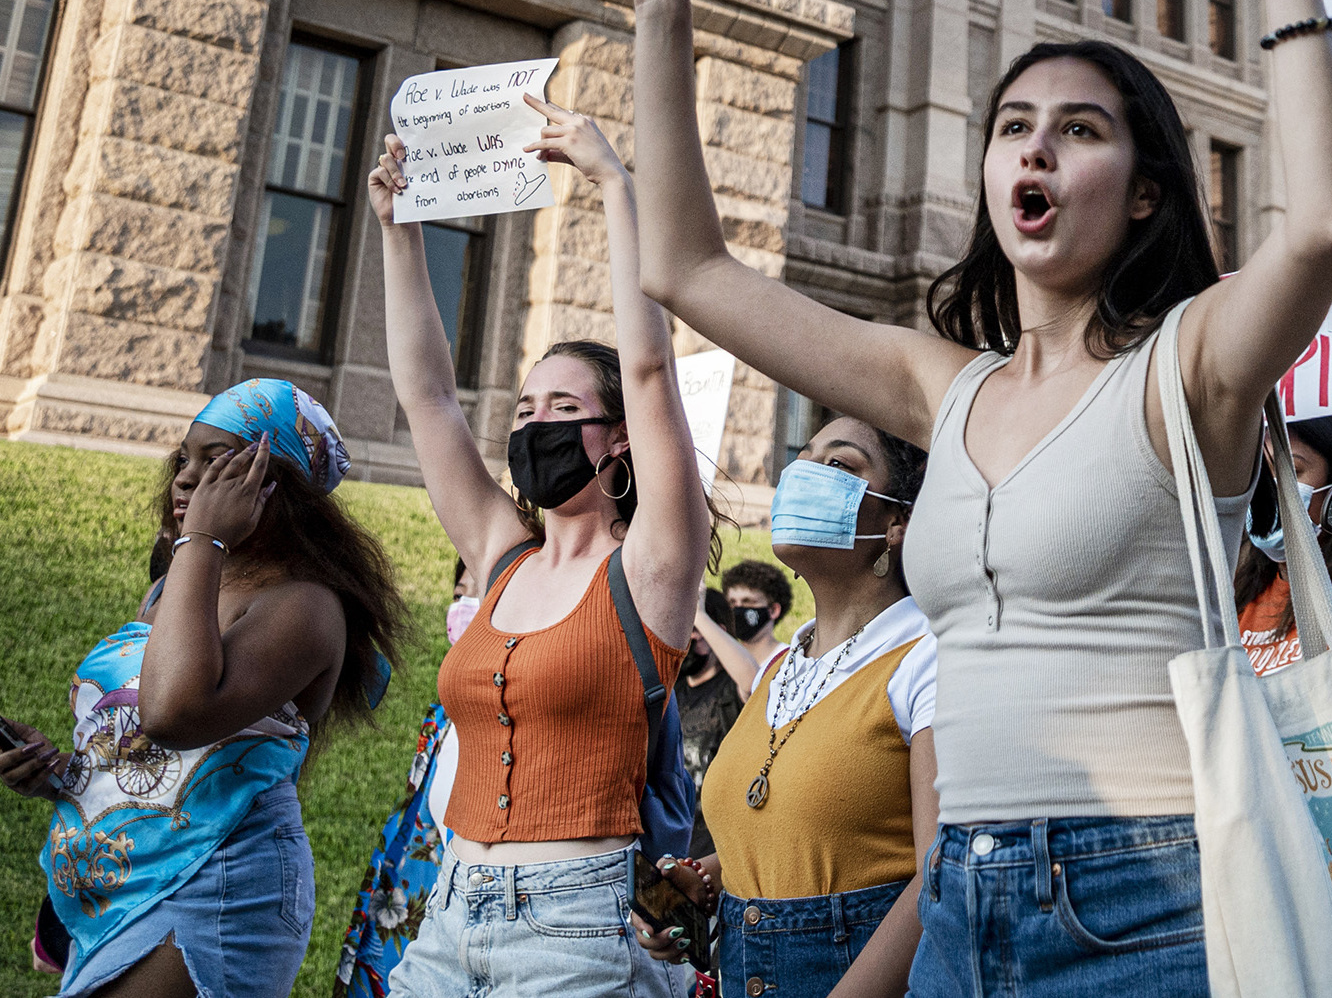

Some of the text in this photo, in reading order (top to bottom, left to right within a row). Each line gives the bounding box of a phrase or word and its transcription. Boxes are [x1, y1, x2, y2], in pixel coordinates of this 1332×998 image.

[405, 82, 428, 104] Roe
[450, 78, 479, 99] Wade
[482, 83, 501, 93] was
[397, 100, 511, 129] the beginning of abortions
[440, 141, 468, 156] Wade
[477, 134, 504, 152] WAS
[420, 167, 440, 184] end
[448, 163, 460, 180] of
[463, 163, 488, 183] people
[415, 187, 500, 208] from abortions
